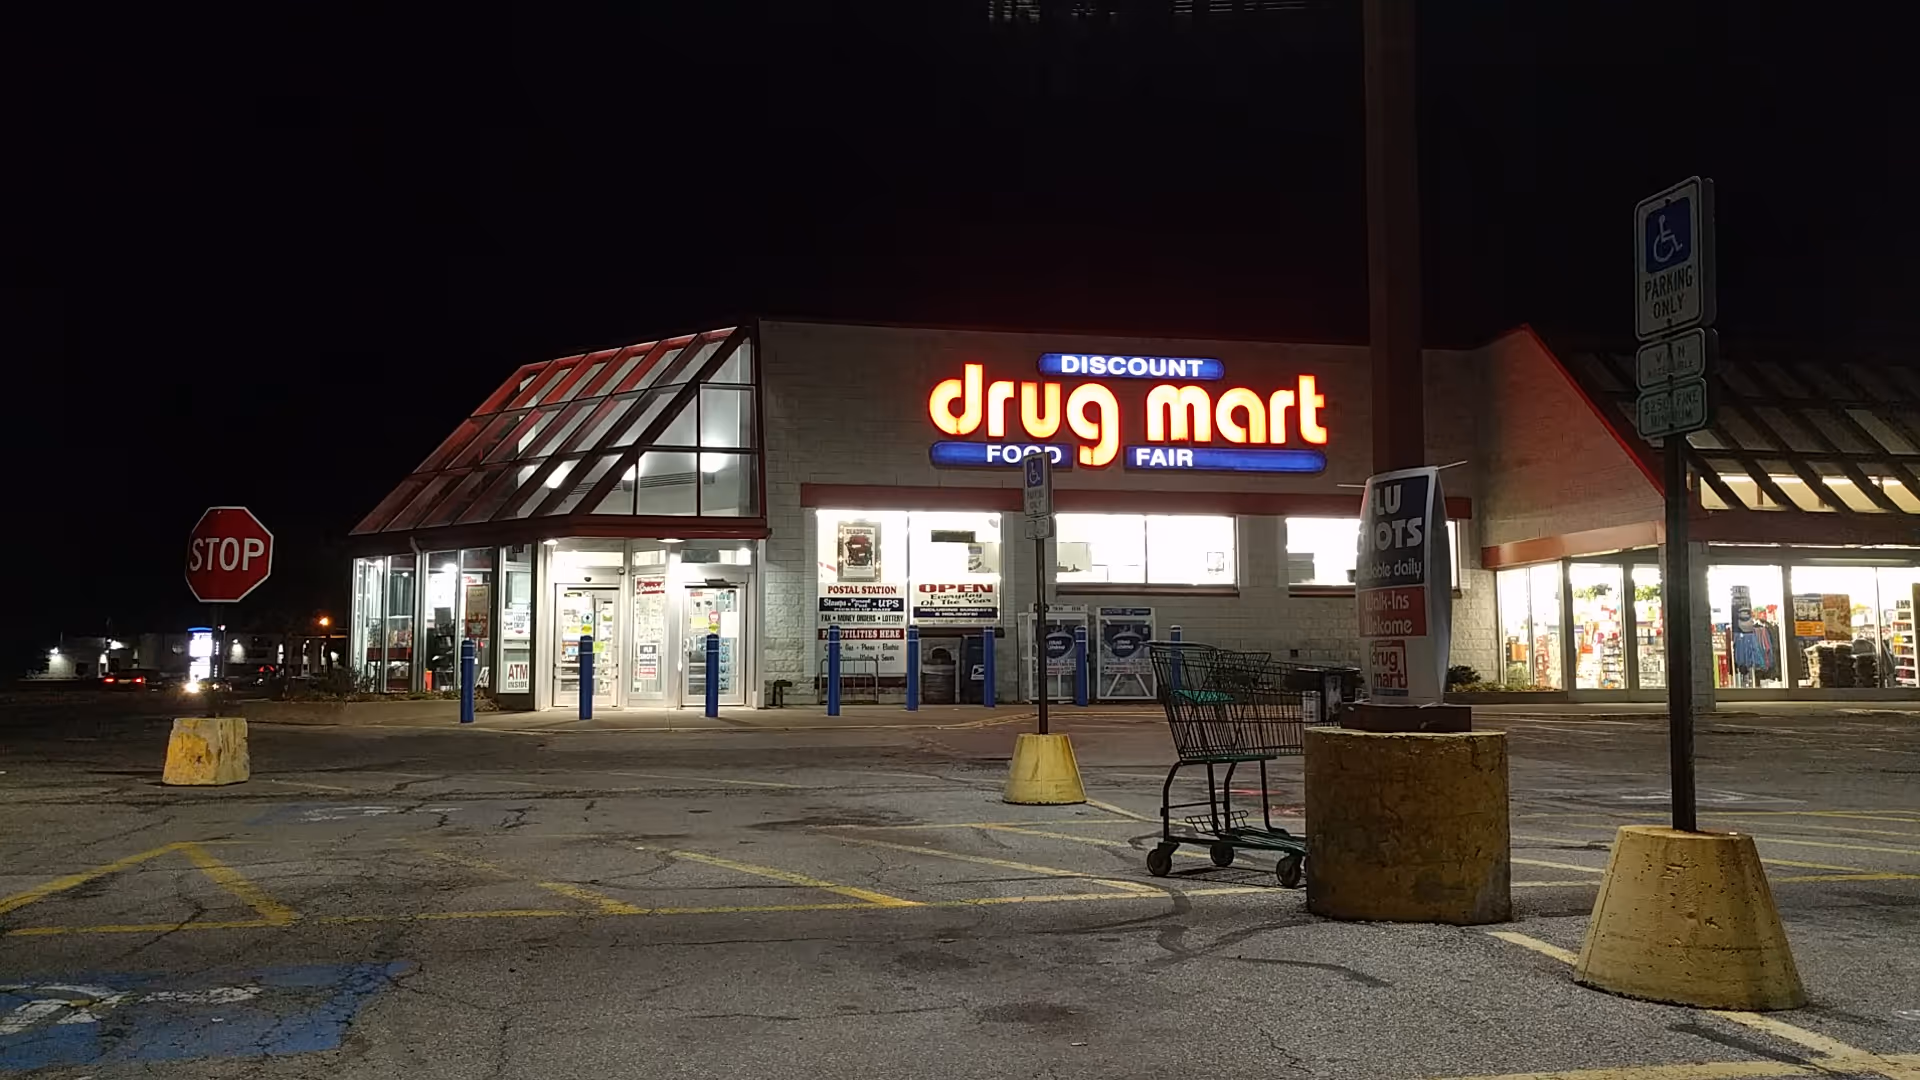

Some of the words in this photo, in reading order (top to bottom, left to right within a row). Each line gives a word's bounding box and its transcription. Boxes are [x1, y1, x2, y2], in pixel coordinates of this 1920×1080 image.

[1644, 264, 1694, 301] PARKING
[1653, 293, 1685, 320] ONLY
[1061, 354, 1203, 378] DISCOUNT
[929, 363, 1120, 467] drug
[1146, 374, 1328, 445] mart
[1135, 448, 1194, 467] FAIR
[189, 536, 265, 571] STOP
[1393, 557, 1422, 581] daily
[827, 585, 860, 595] POSTAL
[861, 585, 897, 595] STATION
[918, 583, 993, 593] OPEN
[930, 592, 983, 600] Everyday
[823, 598, 847, 608] Stamps
[878, 599, 900, 608] UPS
[821, 614, 832, 622] FAX
[837, 614, 856, 622] MONEY
[856, 614, 876, 622] ORDERS
[882, 614, 904, 622] LOTTERY
[840, 631, 878, 639] UTILITIES
[879, 631, 901, 639] HERE
[1371, 651, 1398, 672] drug
[507, 664, 529, 680] ATM
[1373, 670, 1408, 689] mart
[507, 680, 529, 689] INSIDE
